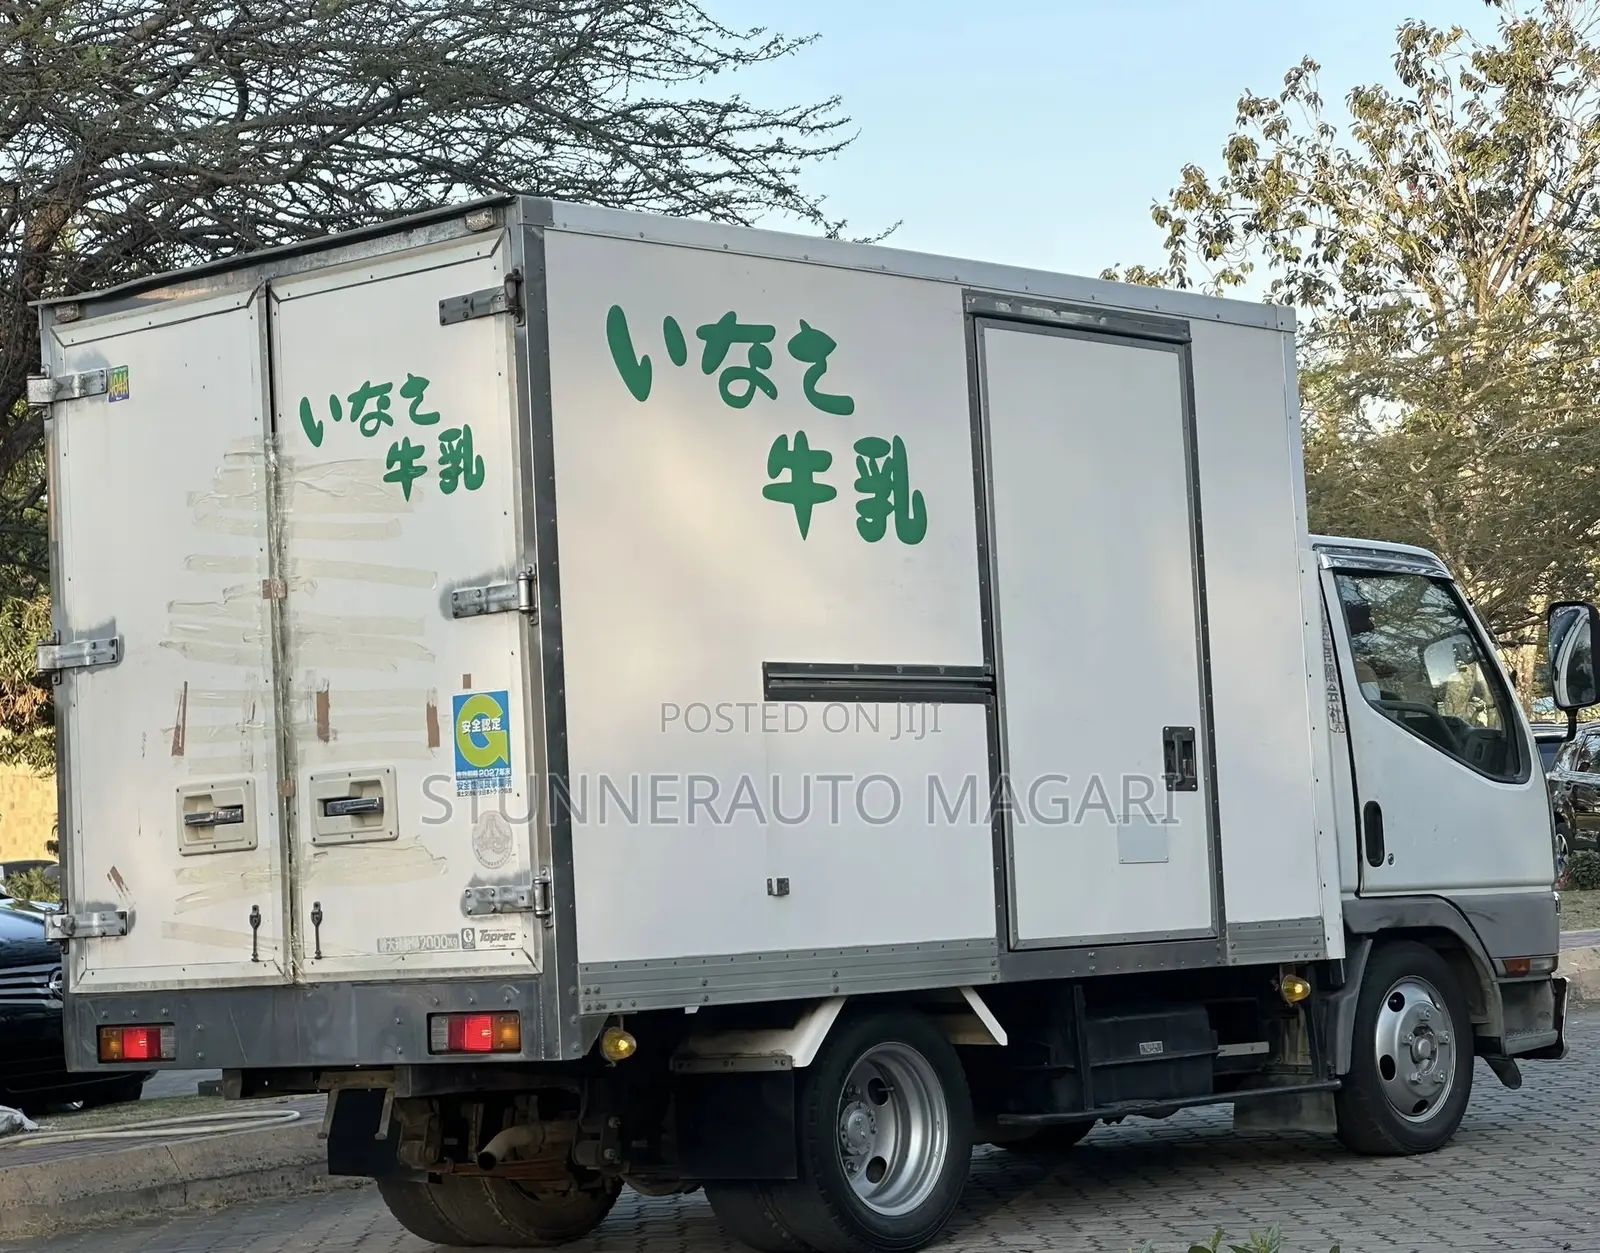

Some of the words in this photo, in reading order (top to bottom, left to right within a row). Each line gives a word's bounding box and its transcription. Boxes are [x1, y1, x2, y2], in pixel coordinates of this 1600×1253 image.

[608, 307, 854, 415] いなさ
[299, 374, 441, 447] いなさ
[384, 426, 485, 499] 牛乳
[763, 432, 927, 544] 牛乳
[461, 717, 501, 734] 安全認定
[479, 929, 516, 944] Toprec
